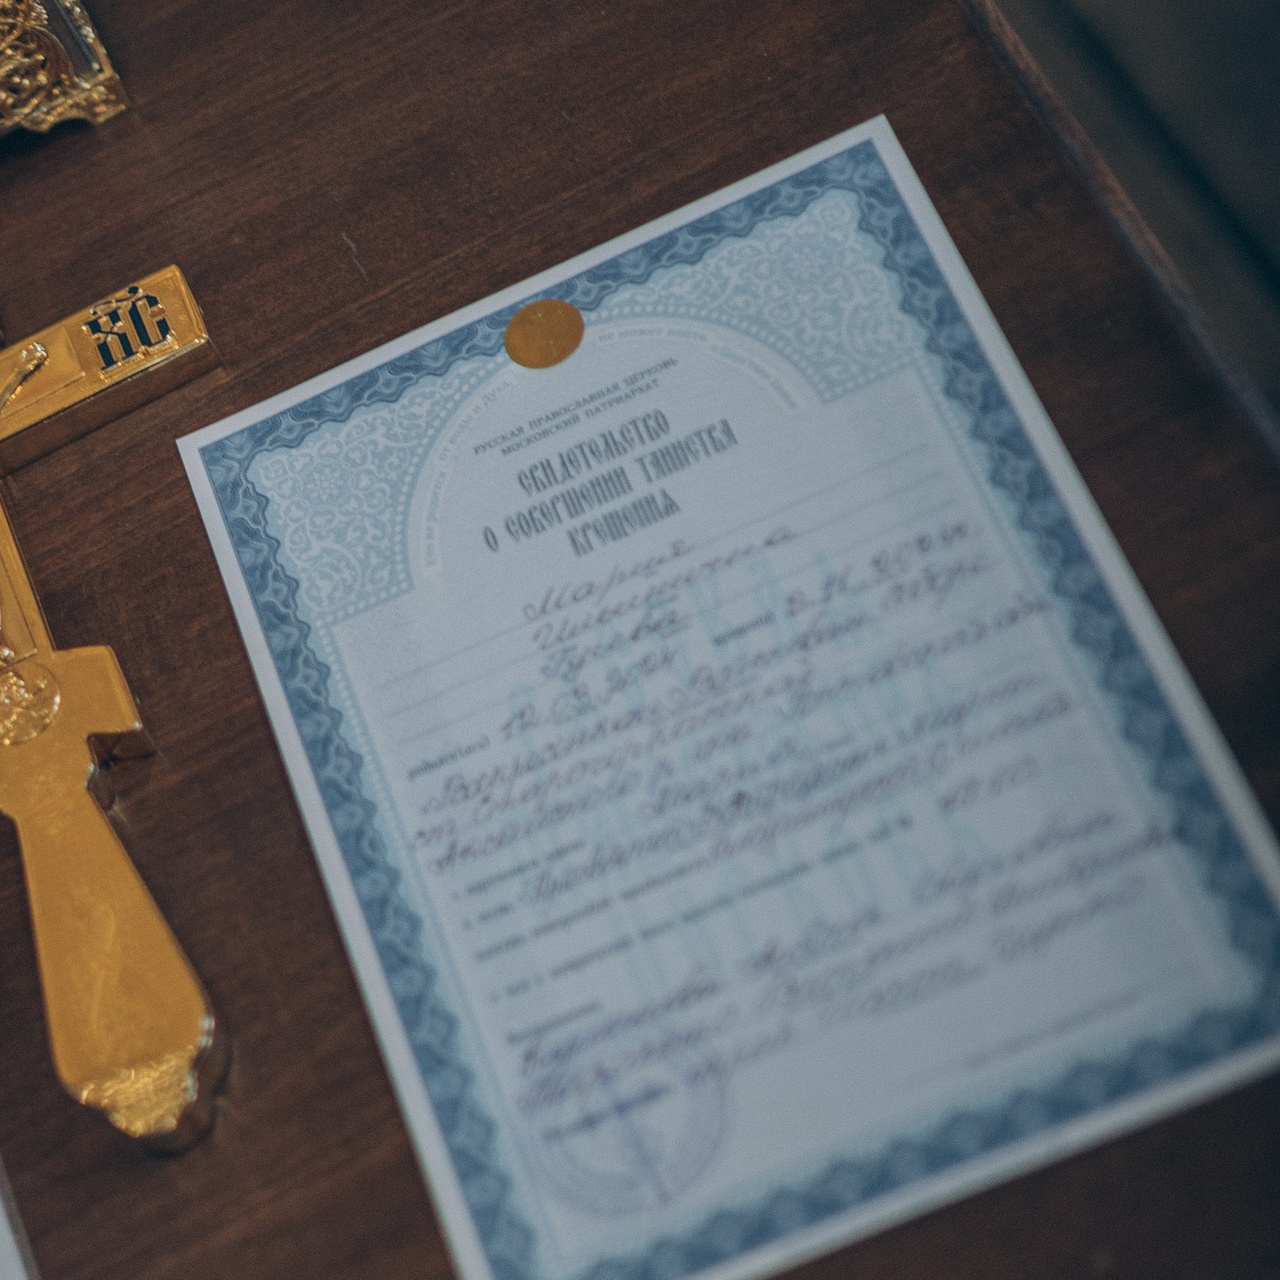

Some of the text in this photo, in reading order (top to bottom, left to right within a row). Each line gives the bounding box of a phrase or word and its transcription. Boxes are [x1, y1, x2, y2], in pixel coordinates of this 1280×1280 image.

[473, 426, 525, 456] РУССКАЯ
[528, 382, 620, 430] ПРАВОСЛАВНАЯ
[623, 357, 679, 387] ЦЕРКОВЬ
[501, 378, 660, 457] МОСКОВСКИЙ ПАТРИАРХАТ
[505, 465, 634, 543] СОВЕРШЕНИИ
[634, 418, 738, 484] ТАИНСТВА
[517, 408, 670, 496] СВИДЕТЕЛЬСТВО
[566, 487, 682, 557] КРЕЩЕНИЯ
